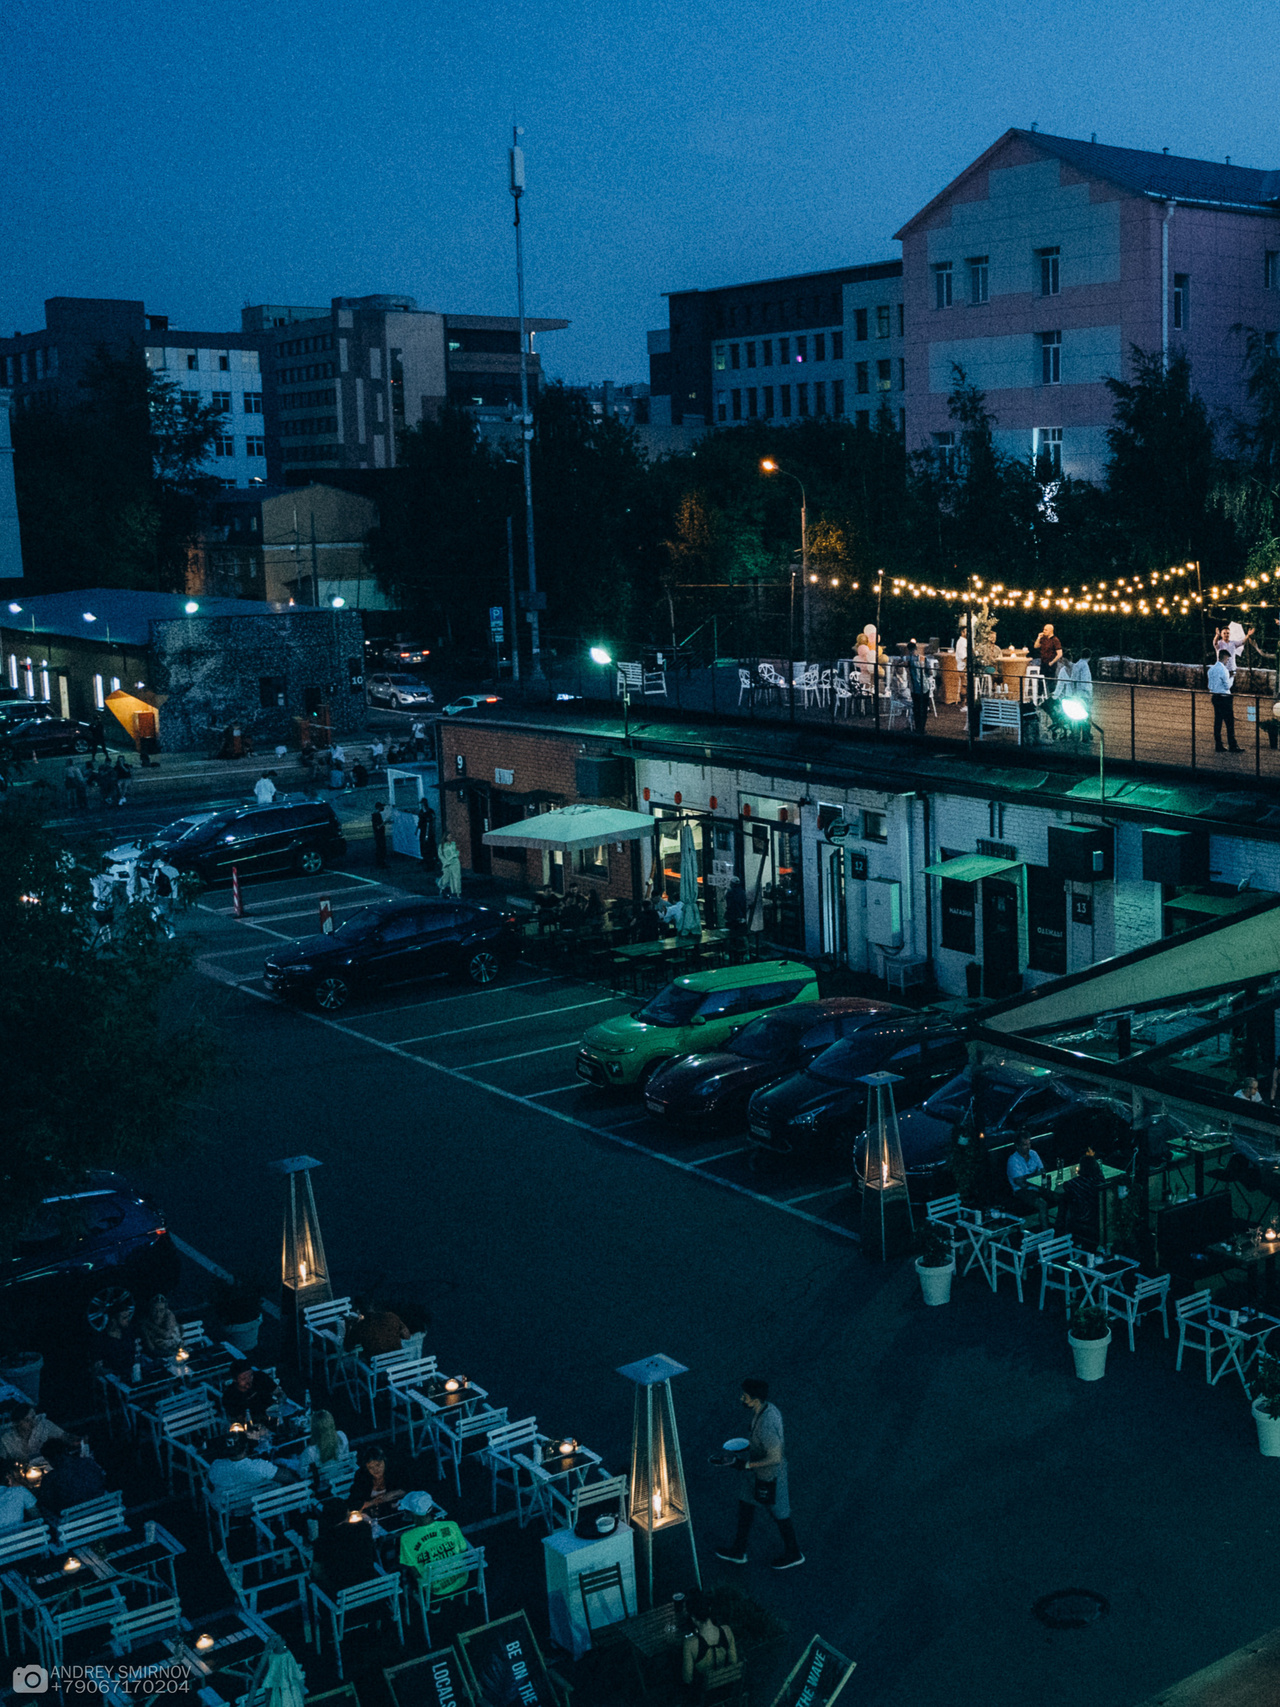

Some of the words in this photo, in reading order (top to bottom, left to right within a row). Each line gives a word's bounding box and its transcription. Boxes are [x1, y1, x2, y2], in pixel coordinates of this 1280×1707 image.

[351, 676, 363, 685] 10
[457, 755, 463, 769] 9
[1076, 902, 1087, 914] 13
[506, 1640, 522, 1660] BE
[512, 1660, 529, 1681] ON
[806, 1649, 826, 1687] WAVE
[518, 1680, 538, 1706] THE
